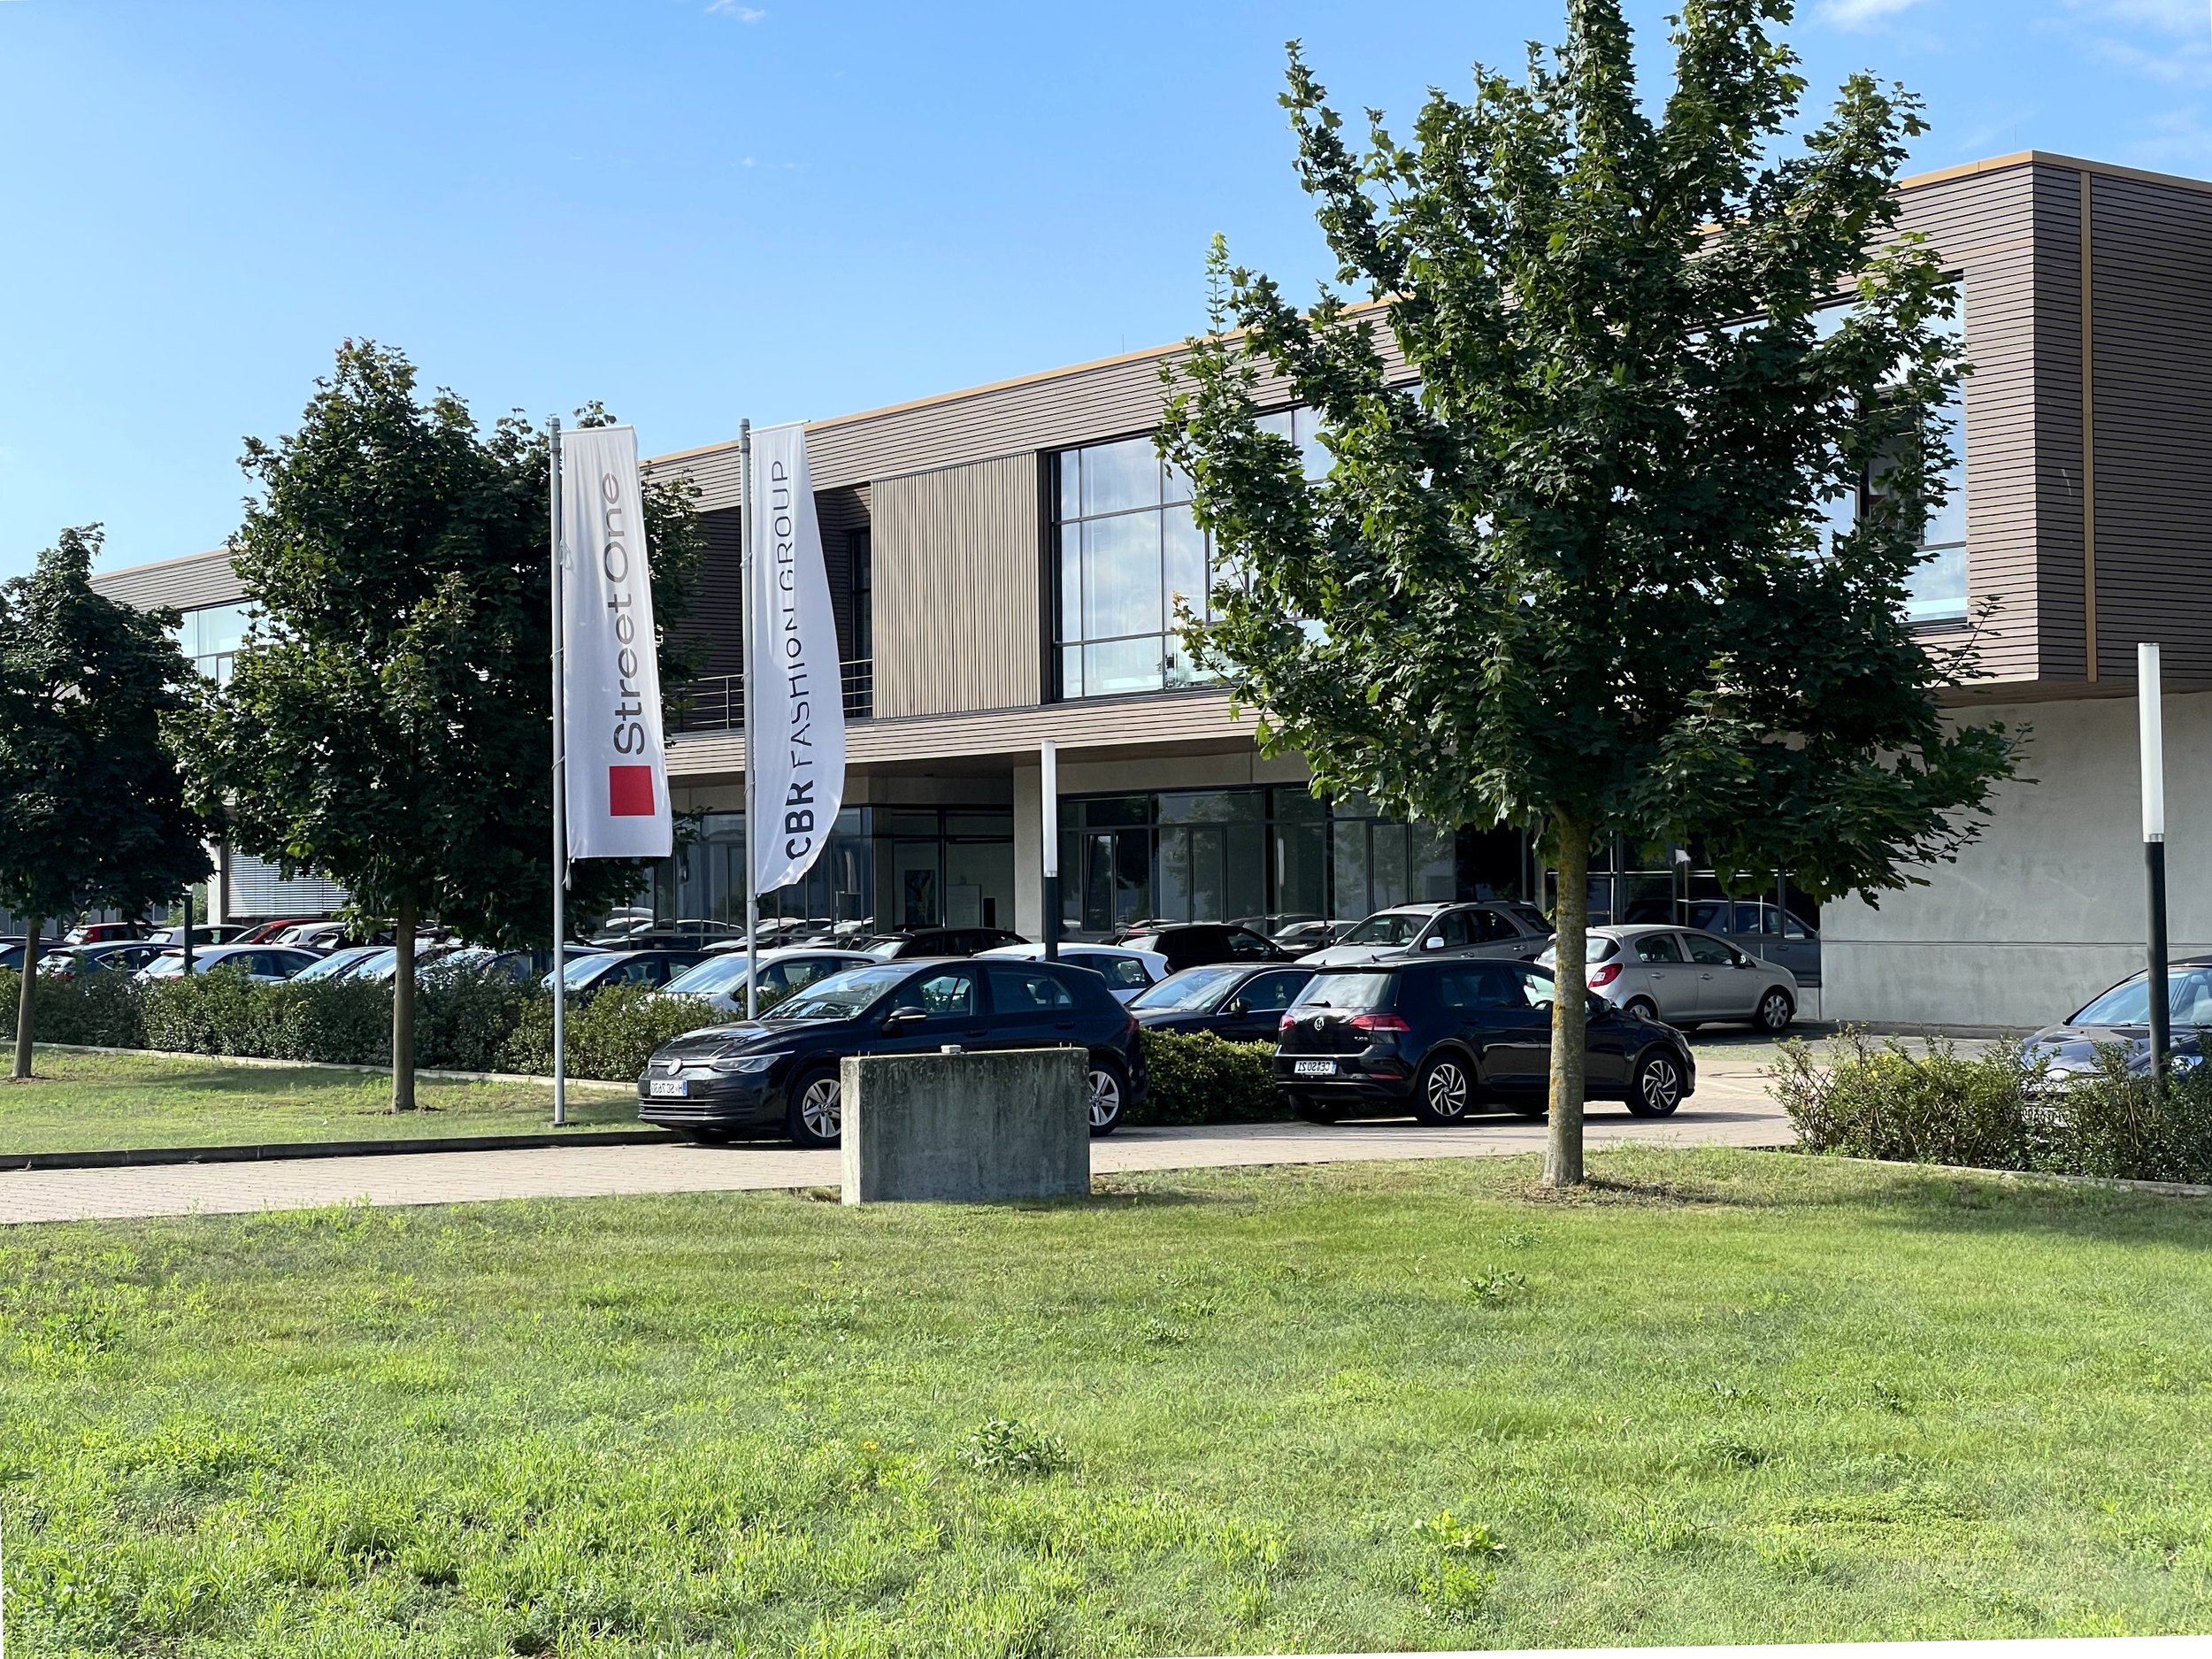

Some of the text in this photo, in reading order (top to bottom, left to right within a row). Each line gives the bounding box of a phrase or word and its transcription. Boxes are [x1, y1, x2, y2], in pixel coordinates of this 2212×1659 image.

[602, 472, 646, 756] Street One
[771, 460, 815, 861] CBR FASHION GROUP
